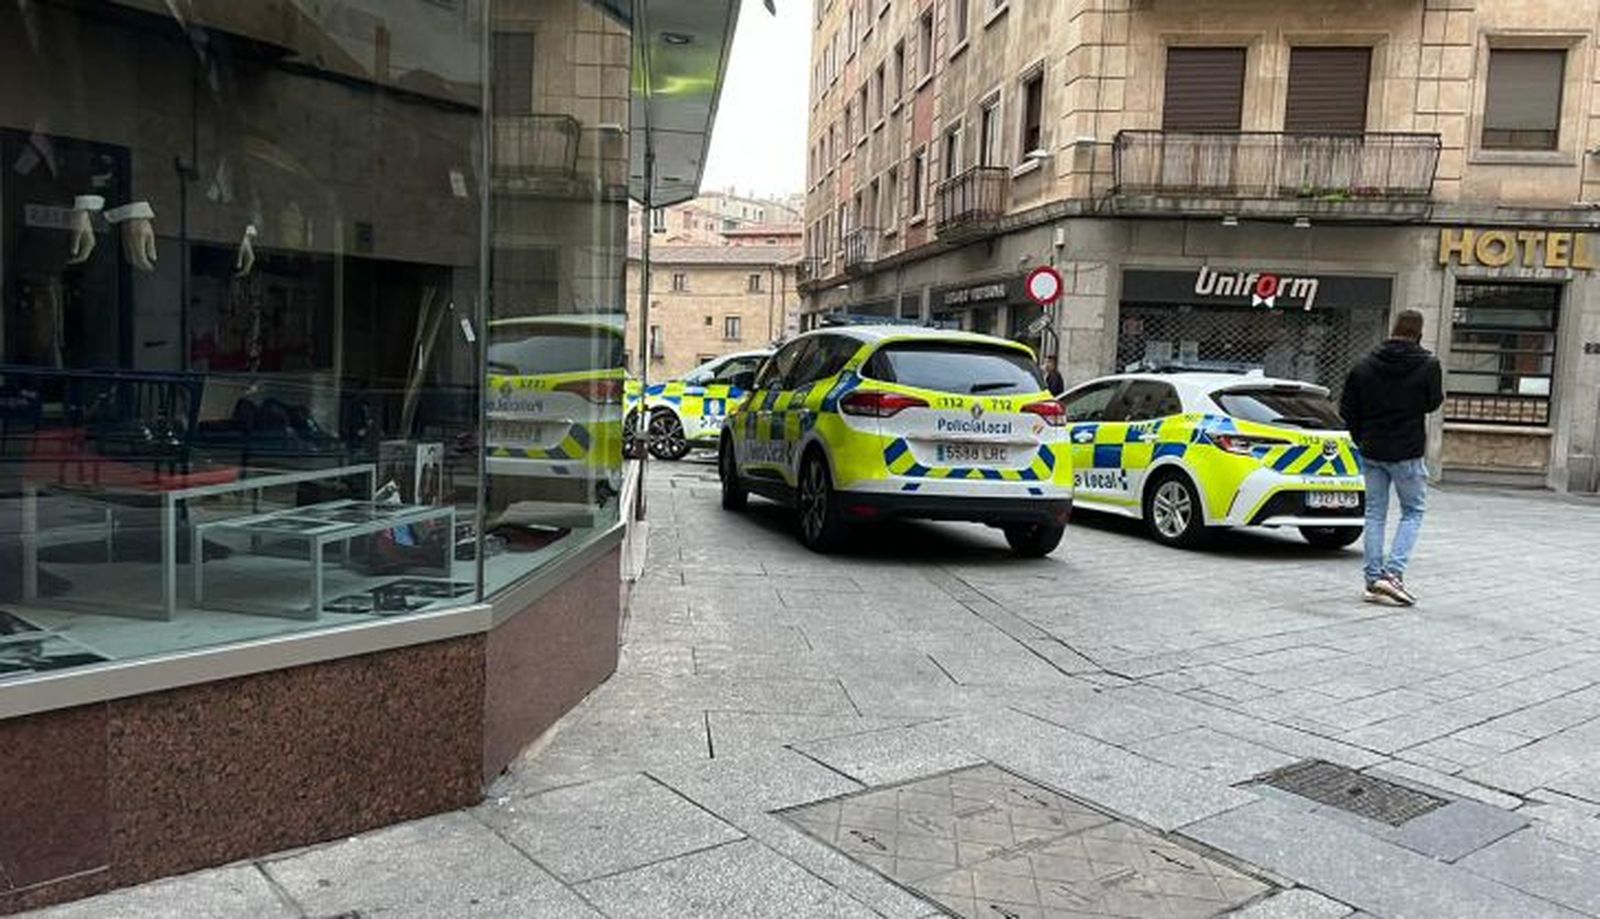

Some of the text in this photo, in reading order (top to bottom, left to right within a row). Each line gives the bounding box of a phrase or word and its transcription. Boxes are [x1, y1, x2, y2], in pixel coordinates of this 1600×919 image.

[1438, 227, 1597, 270] HOTEL
[1195, 266, 1319, 311] Uniform
[943, 397, 964, 408] 112
[990, 399, 1013, 411] 712
